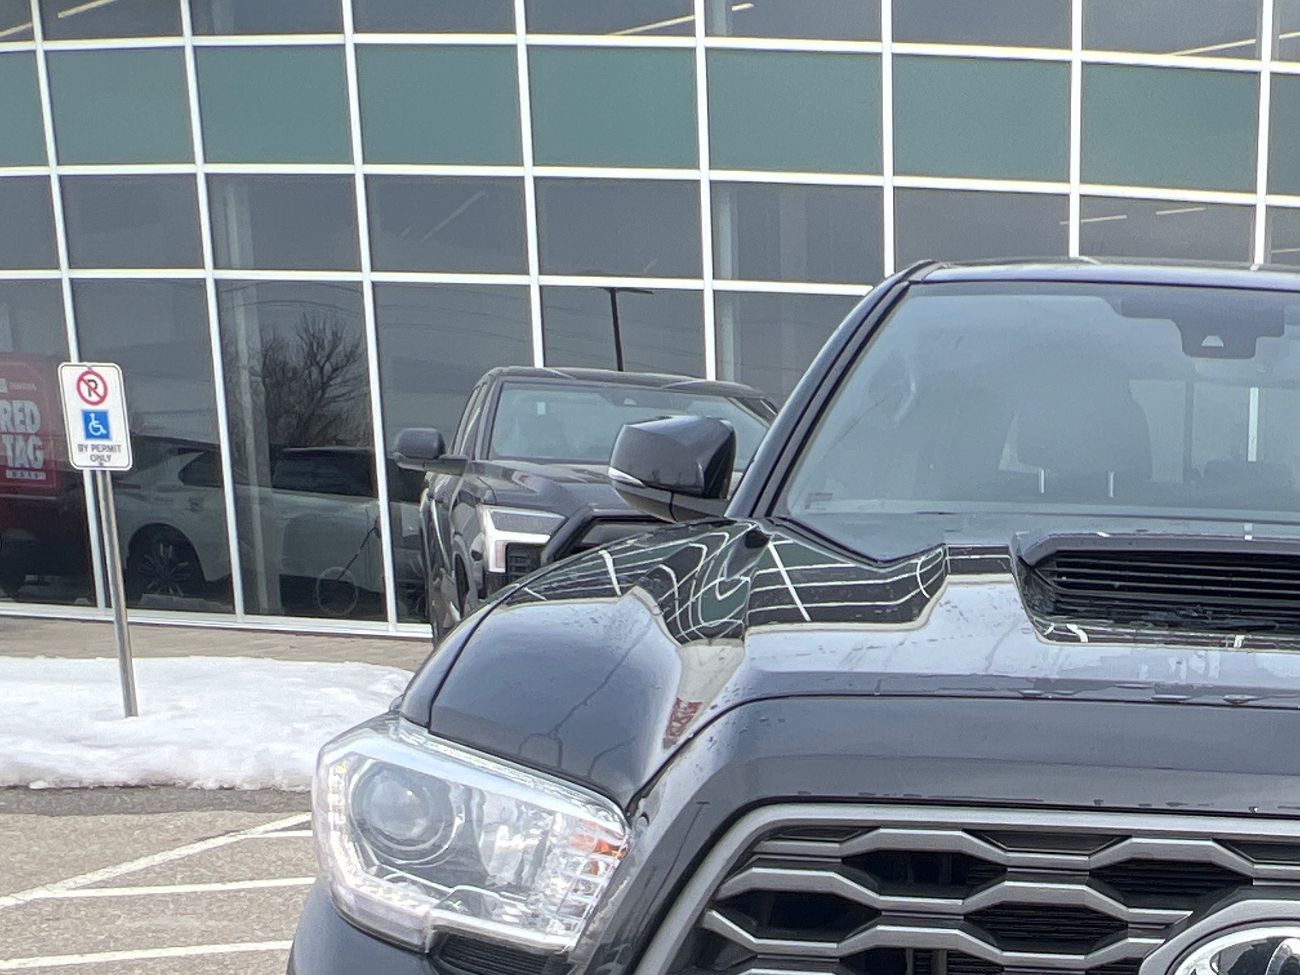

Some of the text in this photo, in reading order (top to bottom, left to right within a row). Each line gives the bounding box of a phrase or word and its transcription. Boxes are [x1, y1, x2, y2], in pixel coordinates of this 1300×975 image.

[0, 400, 41, 433] RED
[1, 433, 44, 469] TAG
[77, 444, 121, 453] BY PERMIT
[90, 454, 111, 463] ONLY
